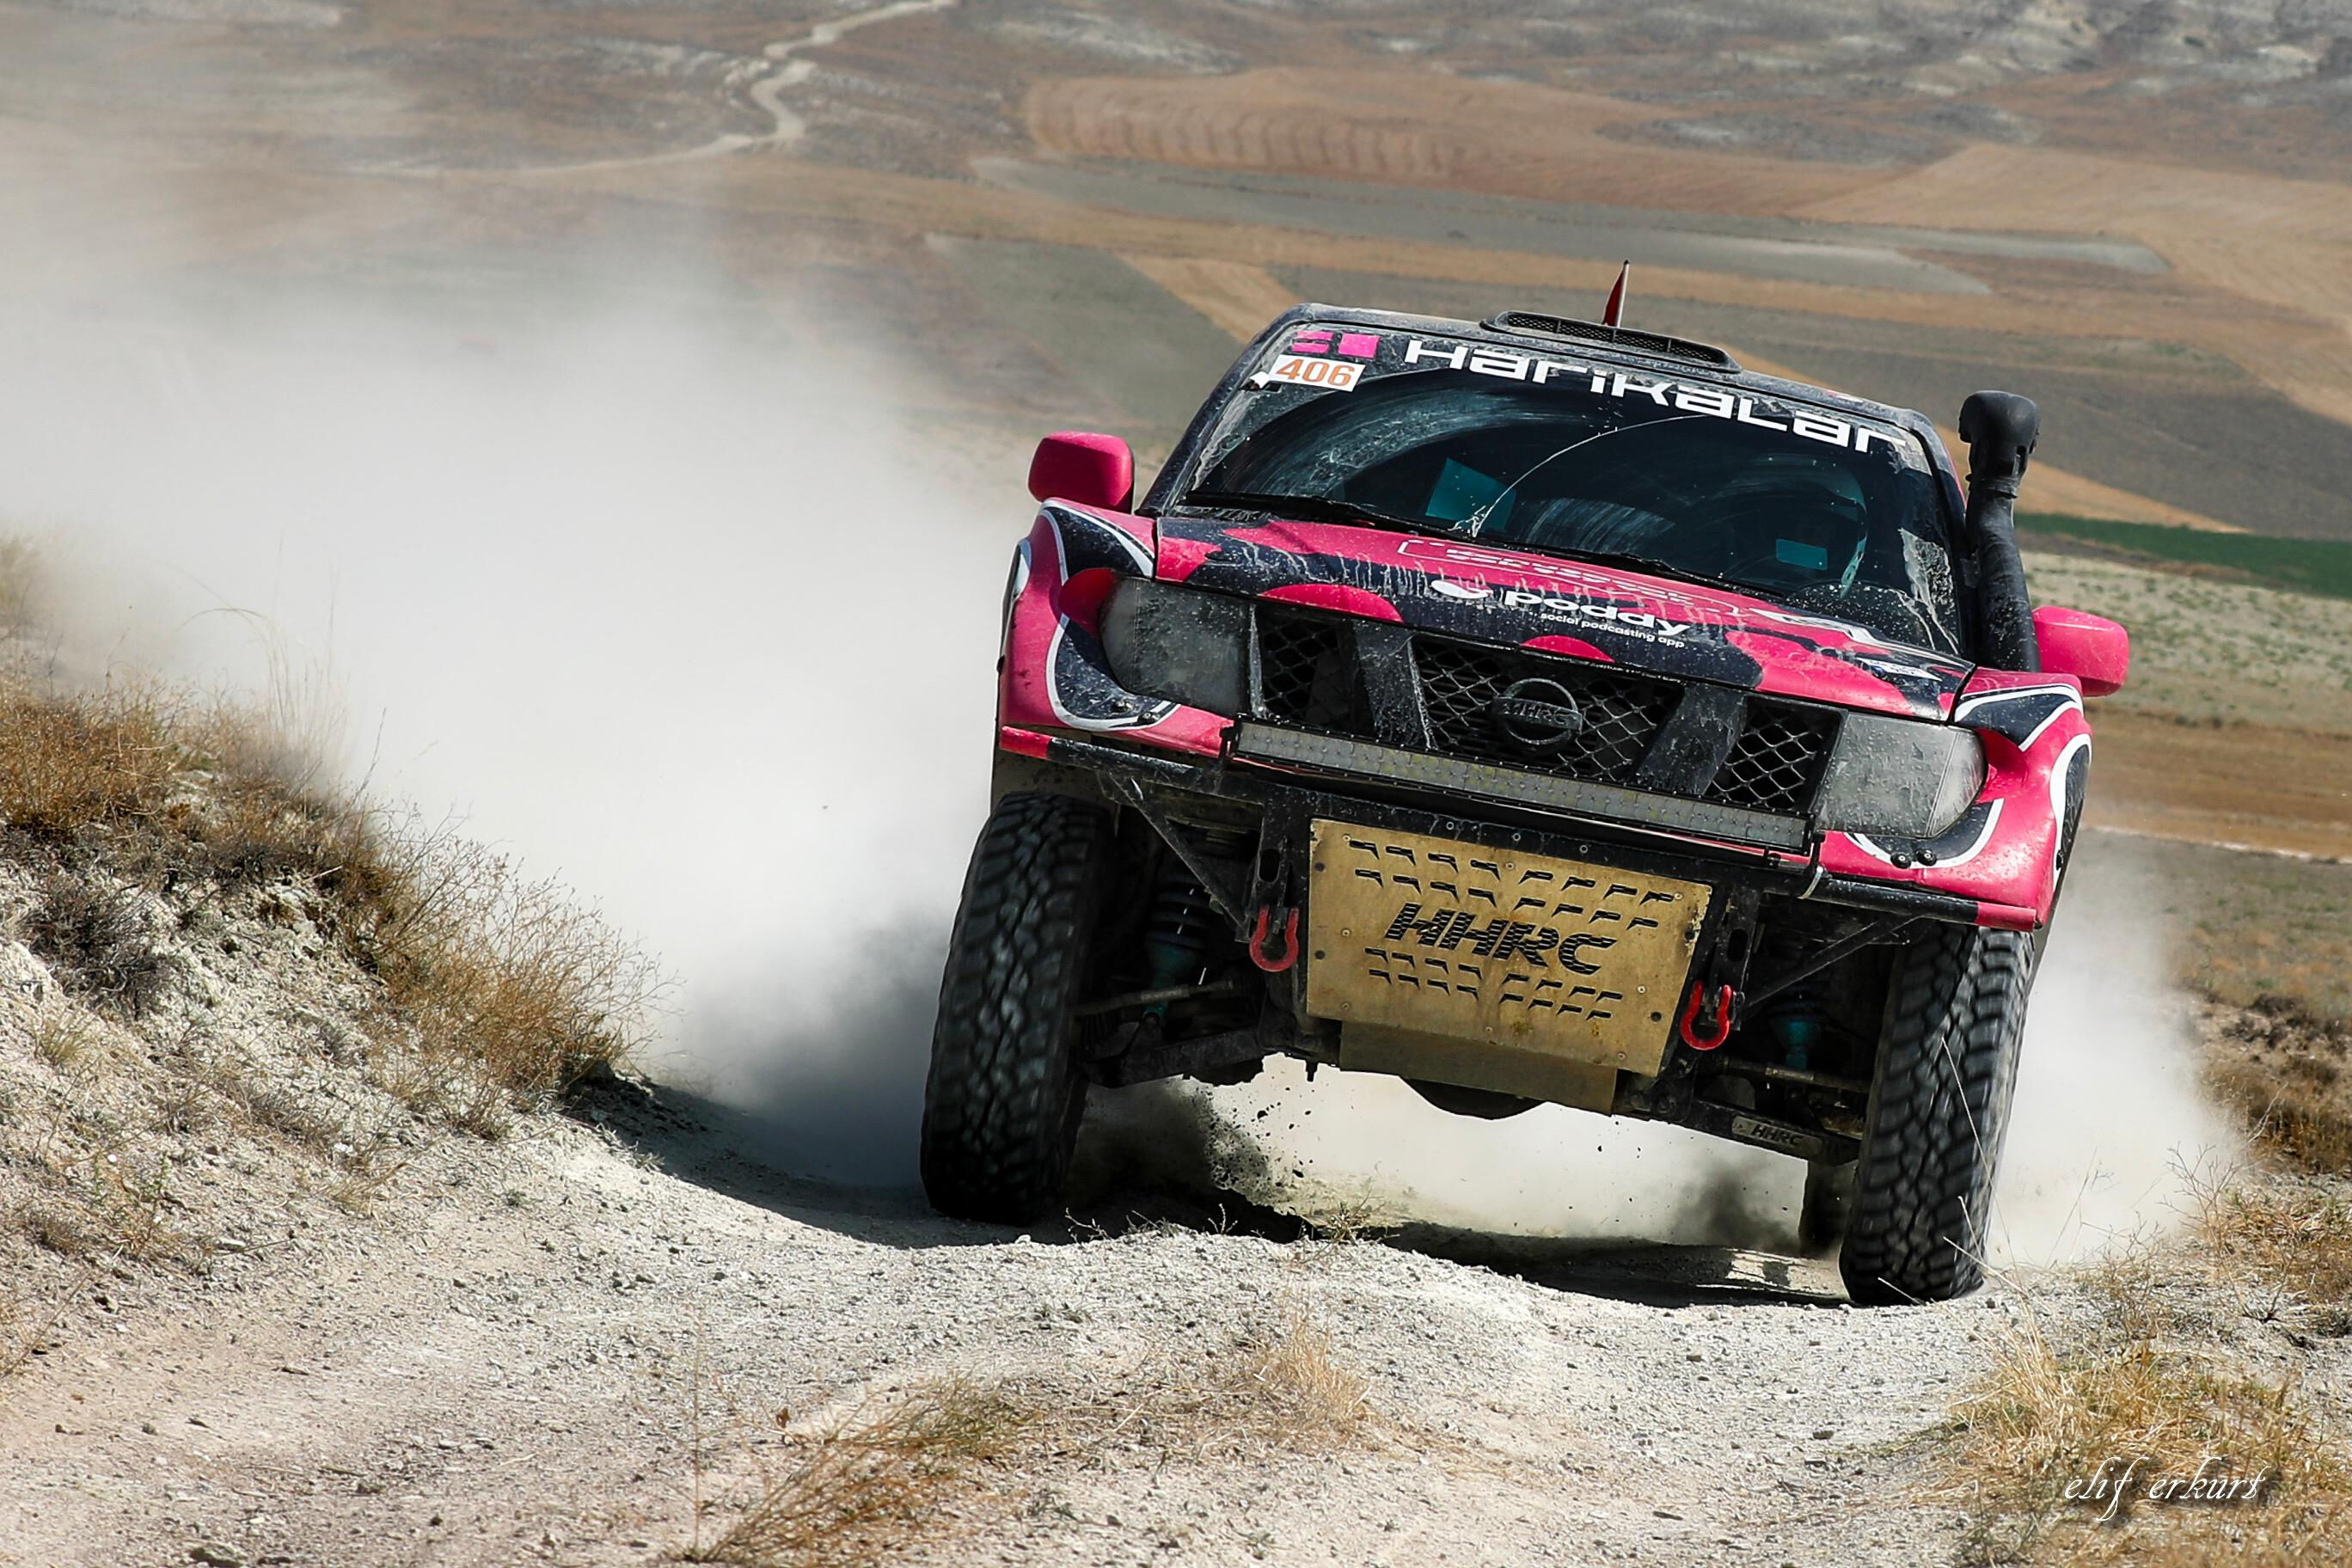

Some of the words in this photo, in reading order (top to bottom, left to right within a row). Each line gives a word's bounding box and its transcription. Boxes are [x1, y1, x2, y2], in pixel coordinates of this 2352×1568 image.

[1276, 358, 1356, 387] 406
[1504, 590, 1691, 637] poddy
[1540, 612, 1578, 626] social
[1580, 620, 1657, 642] podcasting
[1657, 634, 1686, 649] app
[1384, 903, 1618, 976] HHRC
[1751, 1124, 1804, 1147] HHRC
